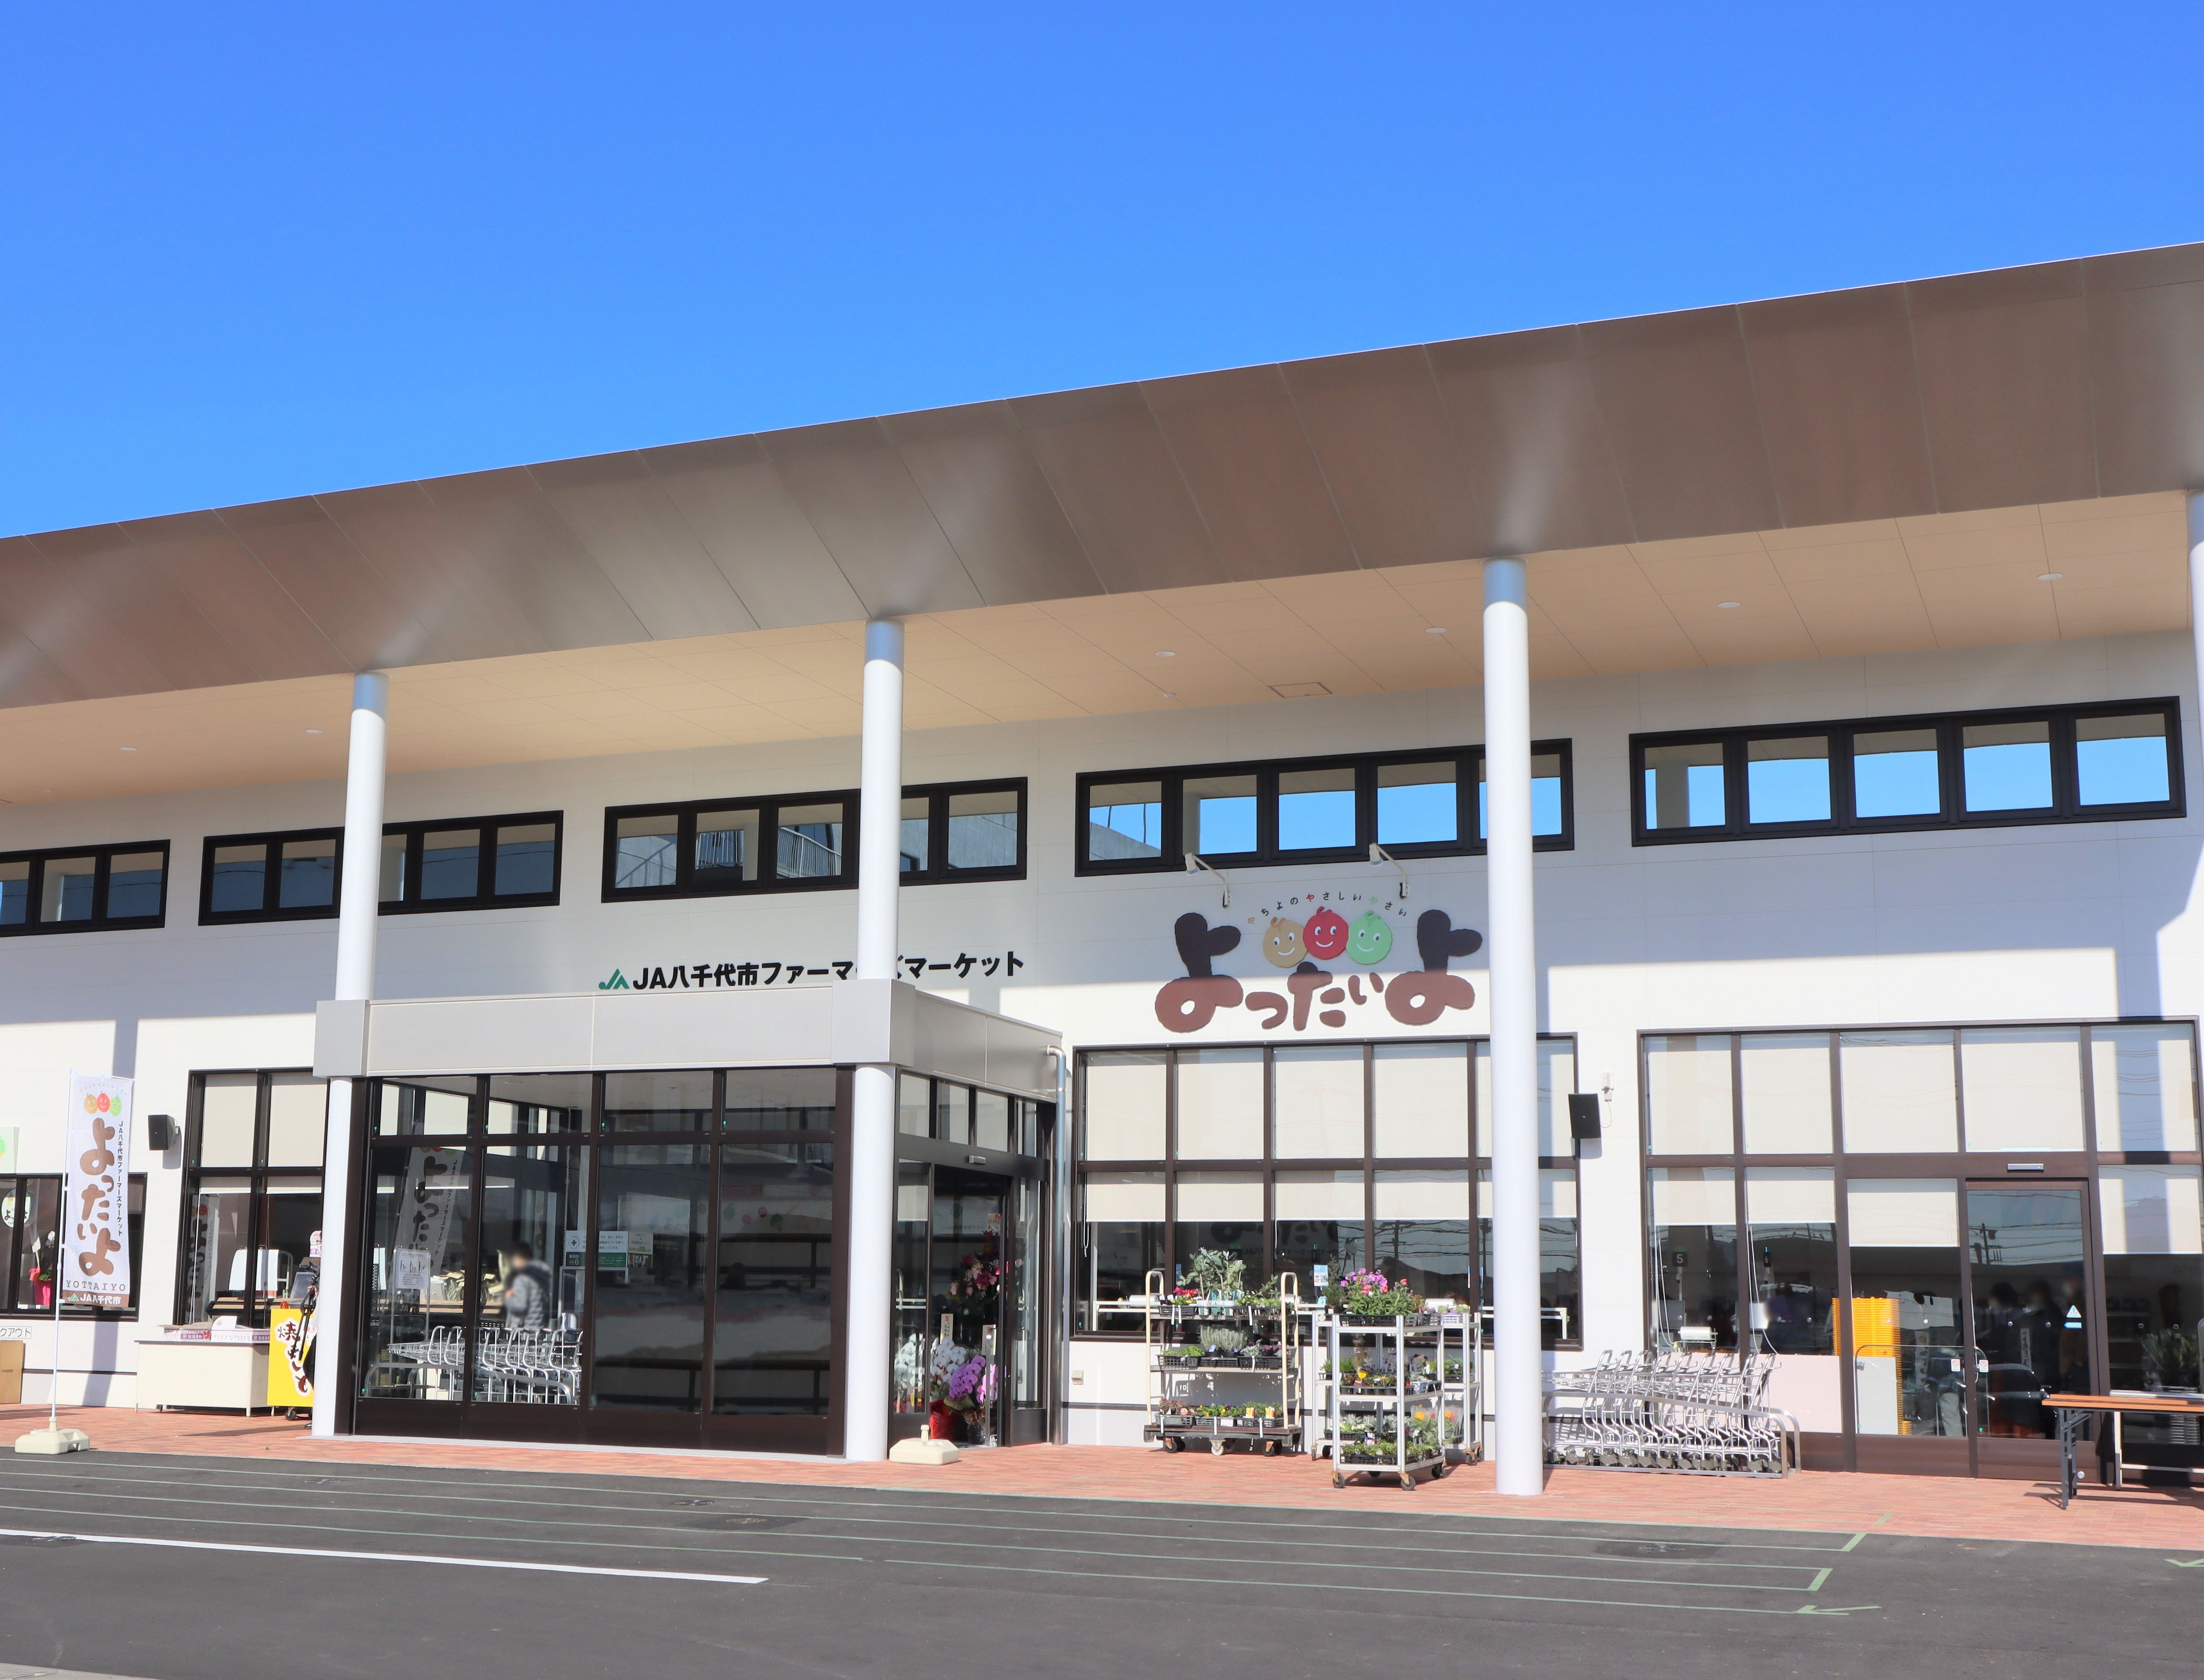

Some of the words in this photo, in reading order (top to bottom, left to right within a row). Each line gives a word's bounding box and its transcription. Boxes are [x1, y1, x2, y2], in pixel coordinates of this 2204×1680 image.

[1247, 892, 1407, 924] やちよのやさしいやさい
[633, 950, 1024, 990] JA八千代市ファーママーケット
[1155, 909, 1483, 1033] よったいよ
[77, 1118, 121, 1276] よったいよ
[1677, 1254, 1683, 1264] 5
[66, 1280, 126, 1291] YOTTAIYO
[80, 1293, 122, 1305] JA八千代市
[0, 1328, 31, 1338] クアウト
